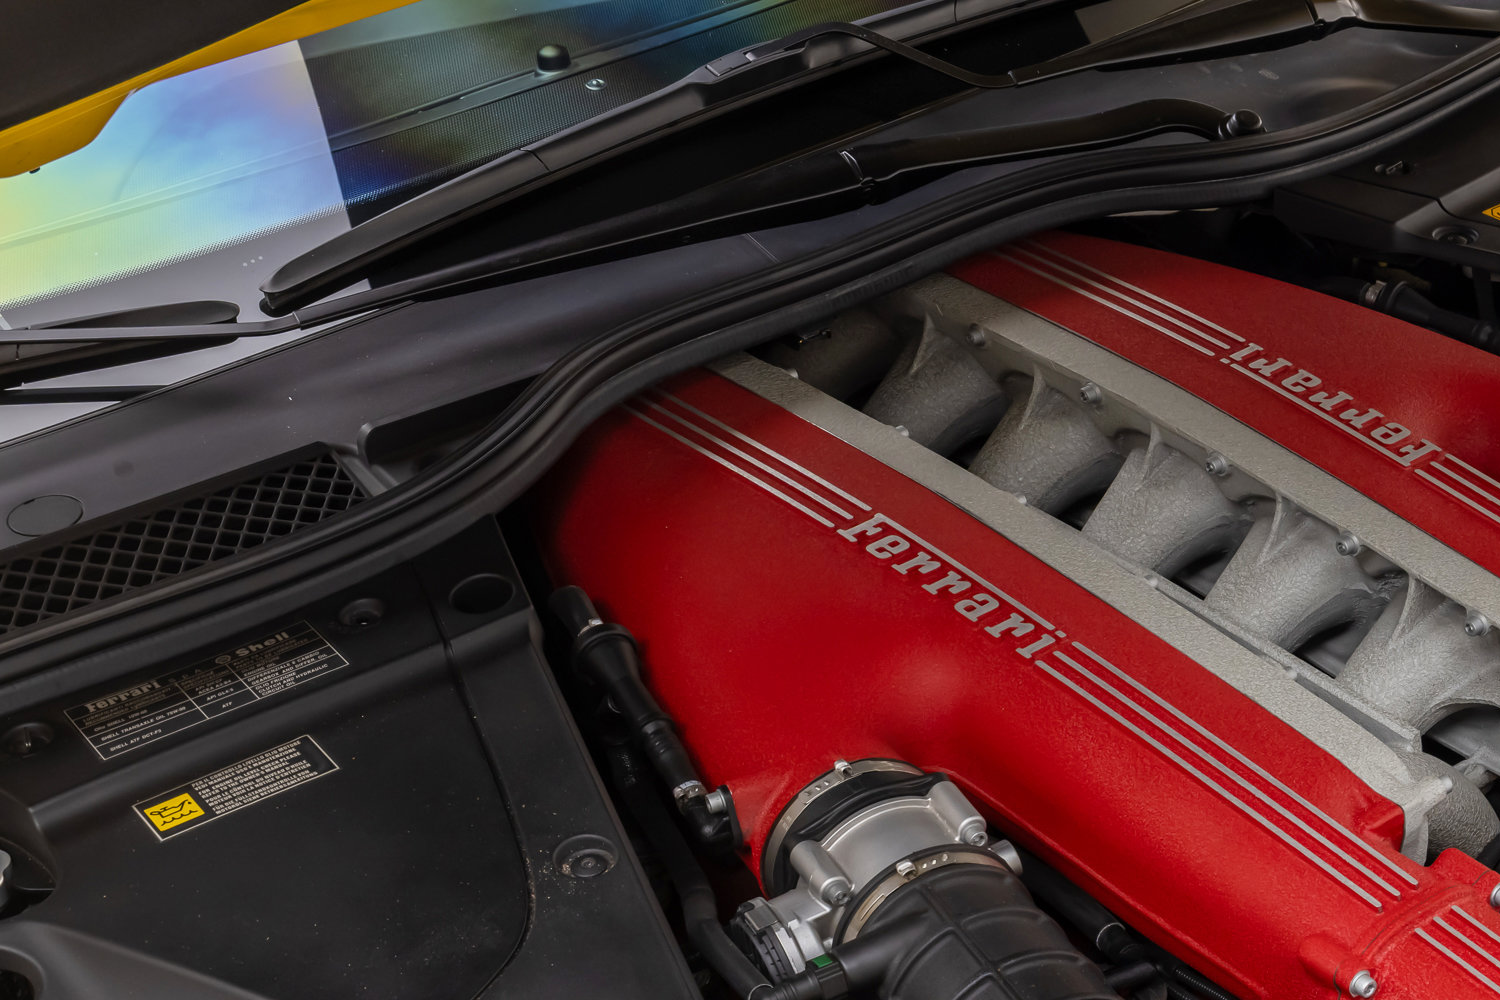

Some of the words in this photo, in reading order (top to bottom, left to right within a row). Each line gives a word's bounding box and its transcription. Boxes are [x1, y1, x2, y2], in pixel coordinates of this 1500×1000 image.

[1220, 343, 1443, 467] Ferrari
[836, 513, 1067, 659] Ferrari
[233, 631, 290, 657] Shell
[245, 662, 292, 682] DIFFERENZIALE
[295, 650, 321, 662] CAMBIO
[249, 671, 280, 685] GEARBOX
[280, 665, 295, 673] AND
[256, 681, 282, 693] CLUTCH
[280, 676, 295, 684] AND
[294, 663, 329, 678] HYDRAULIC
[83, 678, 161, 713] Ferrari
[99, 731, 120, 741] SHELL
[119, 717, 155, 733] TRANSAXLE
[108, 741, 129, 751] SHELL
[190, 779, 204, 787] PER
[208, 764, 243, 780] CONTROLLO
[241, 755, 265, 767] LIVELLO
[263, 749, 279, 757] OLIO
[277, 740, 302, 752] MOTORE
[193, 782, 208, 791] VEDI
[207, 771, 236, 785] MANUALE
[252, 747, 296, 767] MANUTENZIONE
[197, 787, 211, 795] FOR
[210, 778, 233, 789] ENGINE
[242, 767, 260, 777] LEVEL
[259, 759, 280, 770] CHECK
[278, 751, 301, 762] PLEASE
[200, 788, 220, 798] REFER
[264, 760, 289, 773] MANUAL
[204, 794, 222, 803] POUR
[263, 768, 286, 779] NIVEAU
[207, 794, 233, 806] MOTEUR
[231, 788, 247, 797] VOIR
[253, 777, 276, 788] NOTICE
[242, 794, 260, 803] SIEHE
